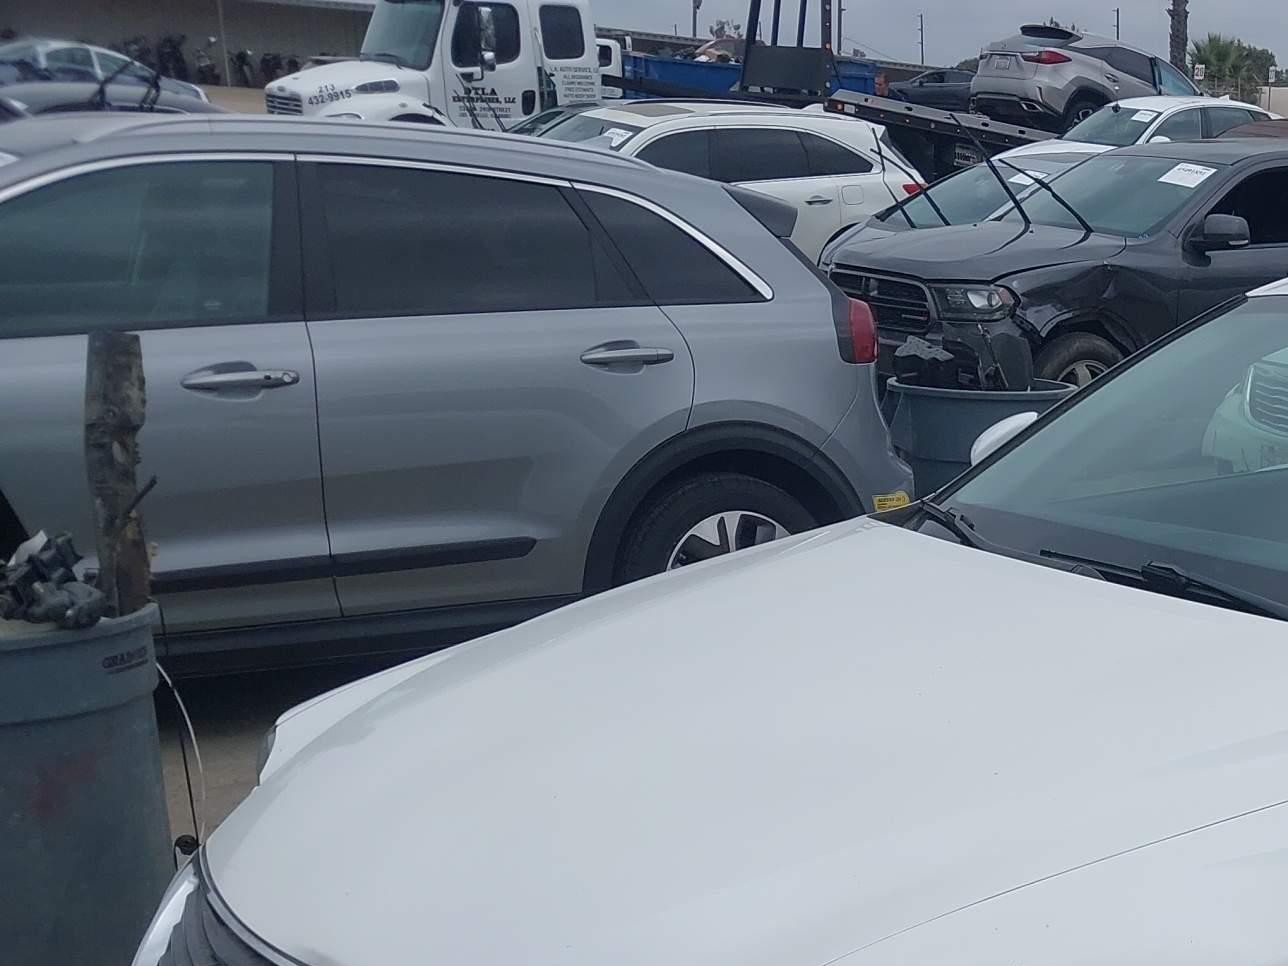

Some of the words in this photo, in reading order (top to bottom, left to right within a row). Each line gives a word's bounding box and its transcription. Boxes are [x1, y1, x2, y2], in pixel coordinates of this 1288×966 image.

[318, 84, 336, 94] 213
[463, 87, 498, 97] DTLA
[307, 88, 353, 106] 432-9915
